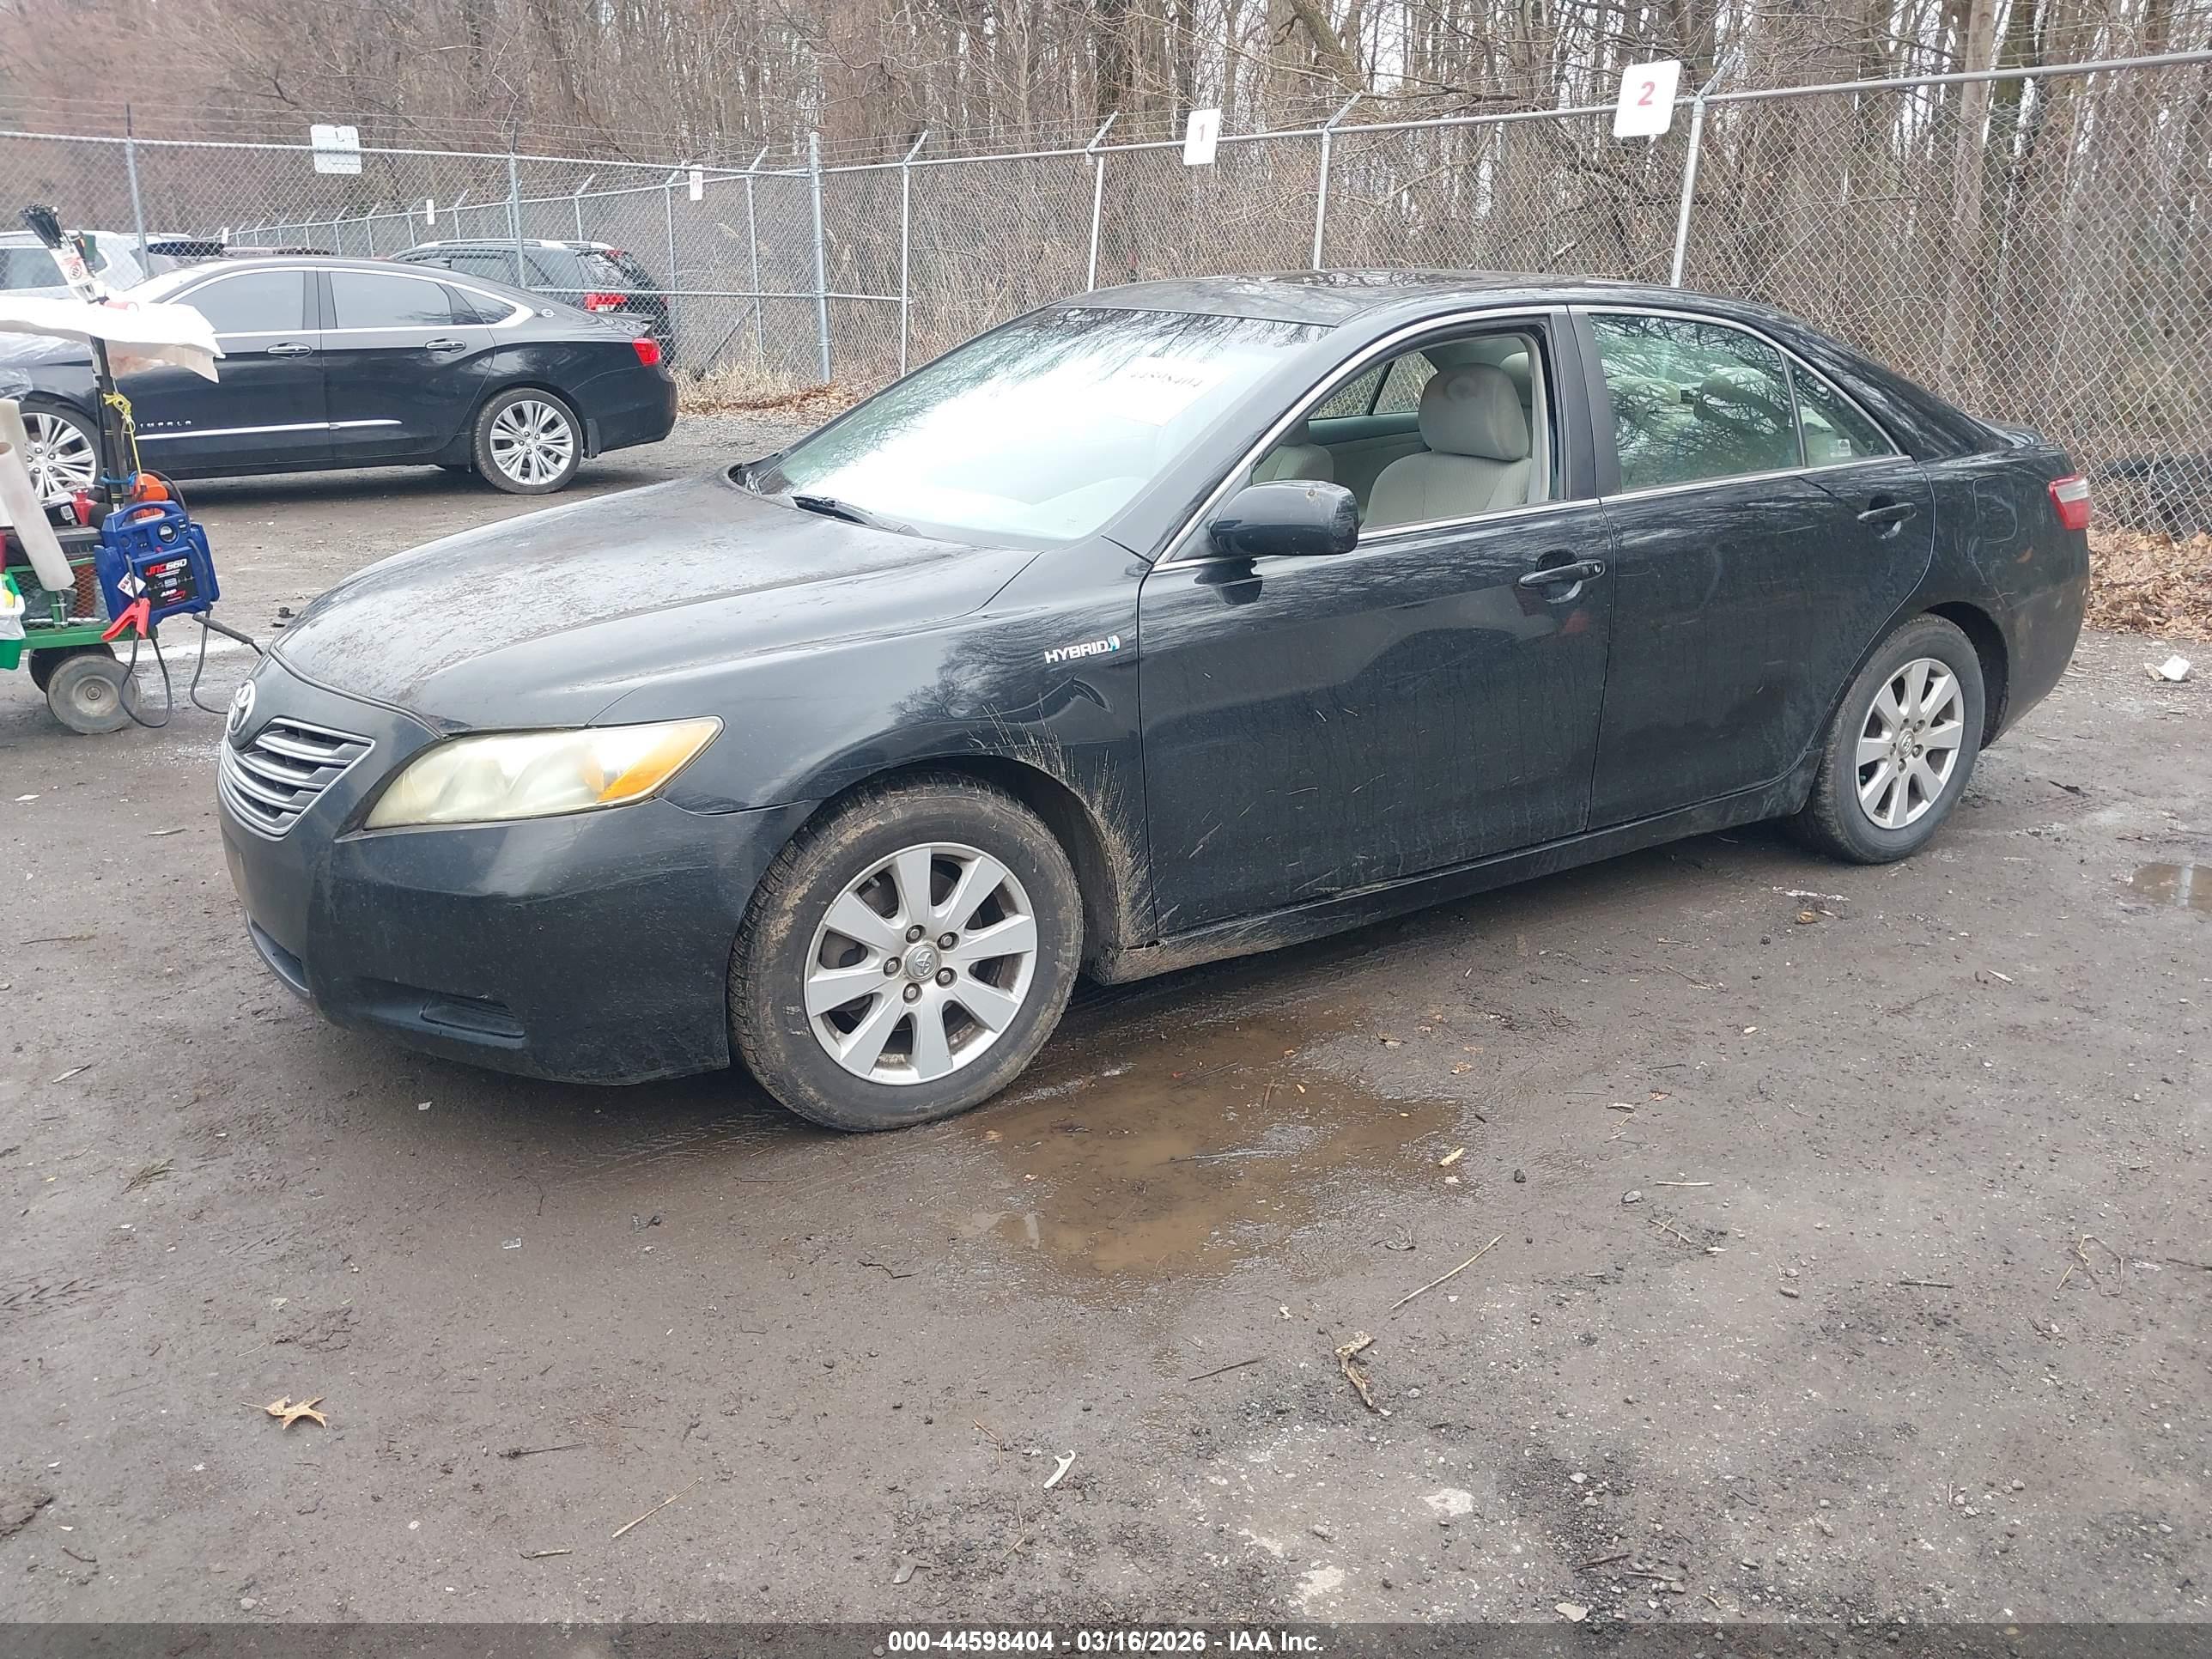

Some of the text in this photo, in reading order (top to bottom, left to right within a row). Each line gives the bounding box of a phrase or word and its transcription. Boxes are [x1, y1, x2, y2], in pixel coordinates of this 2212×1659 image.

[1638, 81, 1656, 106] 2
[1199, 124, 1206, 142] 1
[146, 558, 187, 576] JNC660
[1044, 640, 1109, 664] HYBRID
